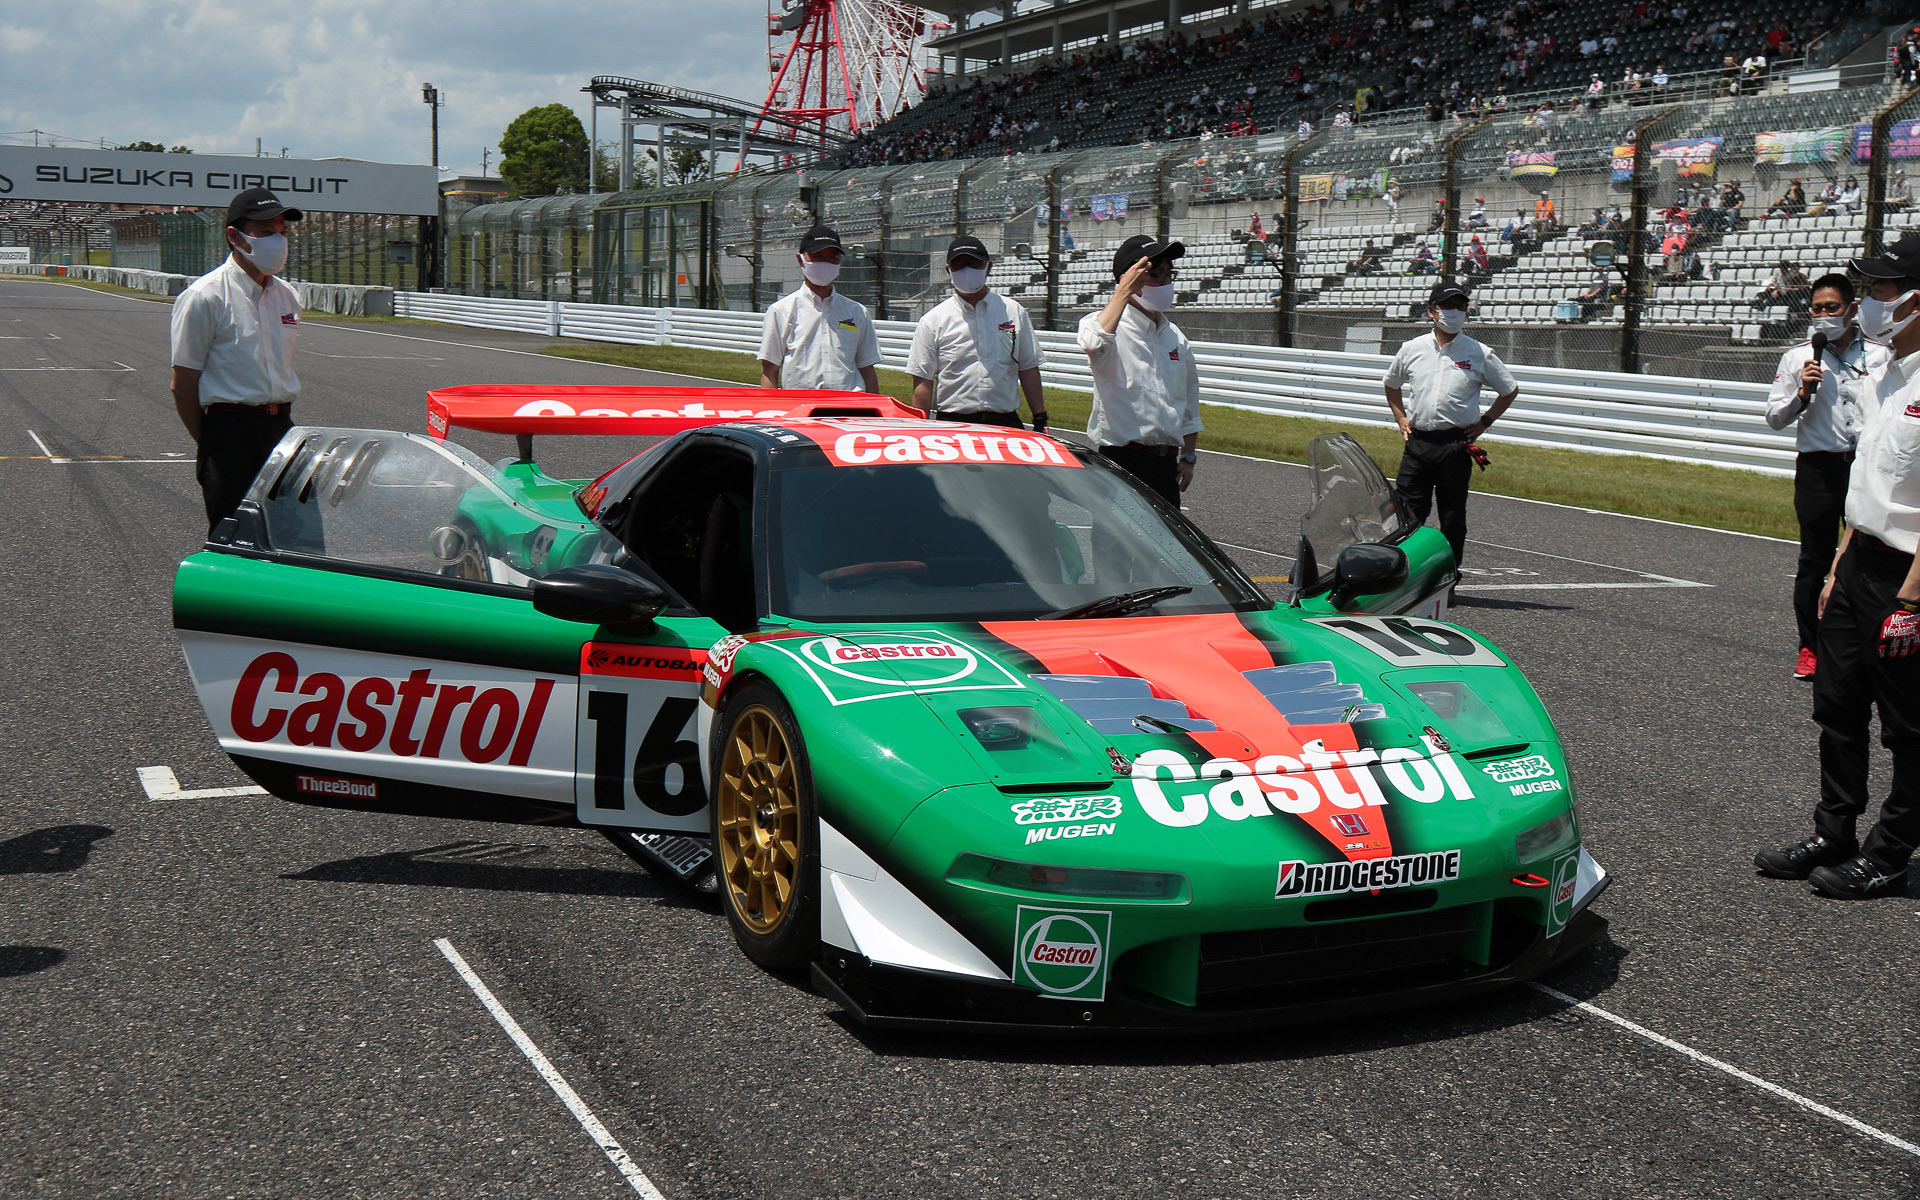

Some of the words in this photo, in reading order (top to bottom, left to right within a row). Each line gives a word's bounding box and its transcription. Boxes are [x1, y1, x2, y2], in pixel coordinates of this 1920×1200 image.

[36, 165, 193, 187] SUZUKA
[206, 172, 348, 194] CIRCUIT
[834, 432, 1066, 465] Castrol
[1320, 617, 1476, 657] 16
[835, 644, 956, 661] Castrol
[231, 651, 556, 767] Castrol
[587, 690, 709, 817] 16
[1131, 735, 1476, 828] Castrol
[1482, 755, 1555, 783] 無限
[298, 775, 377, 797] ThreeBond
[1509, 779, 1562, 796] MUGEN
[1010, 795, 1122, 825] 無限
[1024, 822, 1116, 845] MUGEN
[1275, 850, 1460, 898] BRIDGESTONE
[1033, 943, 1098, 965] Castrol
